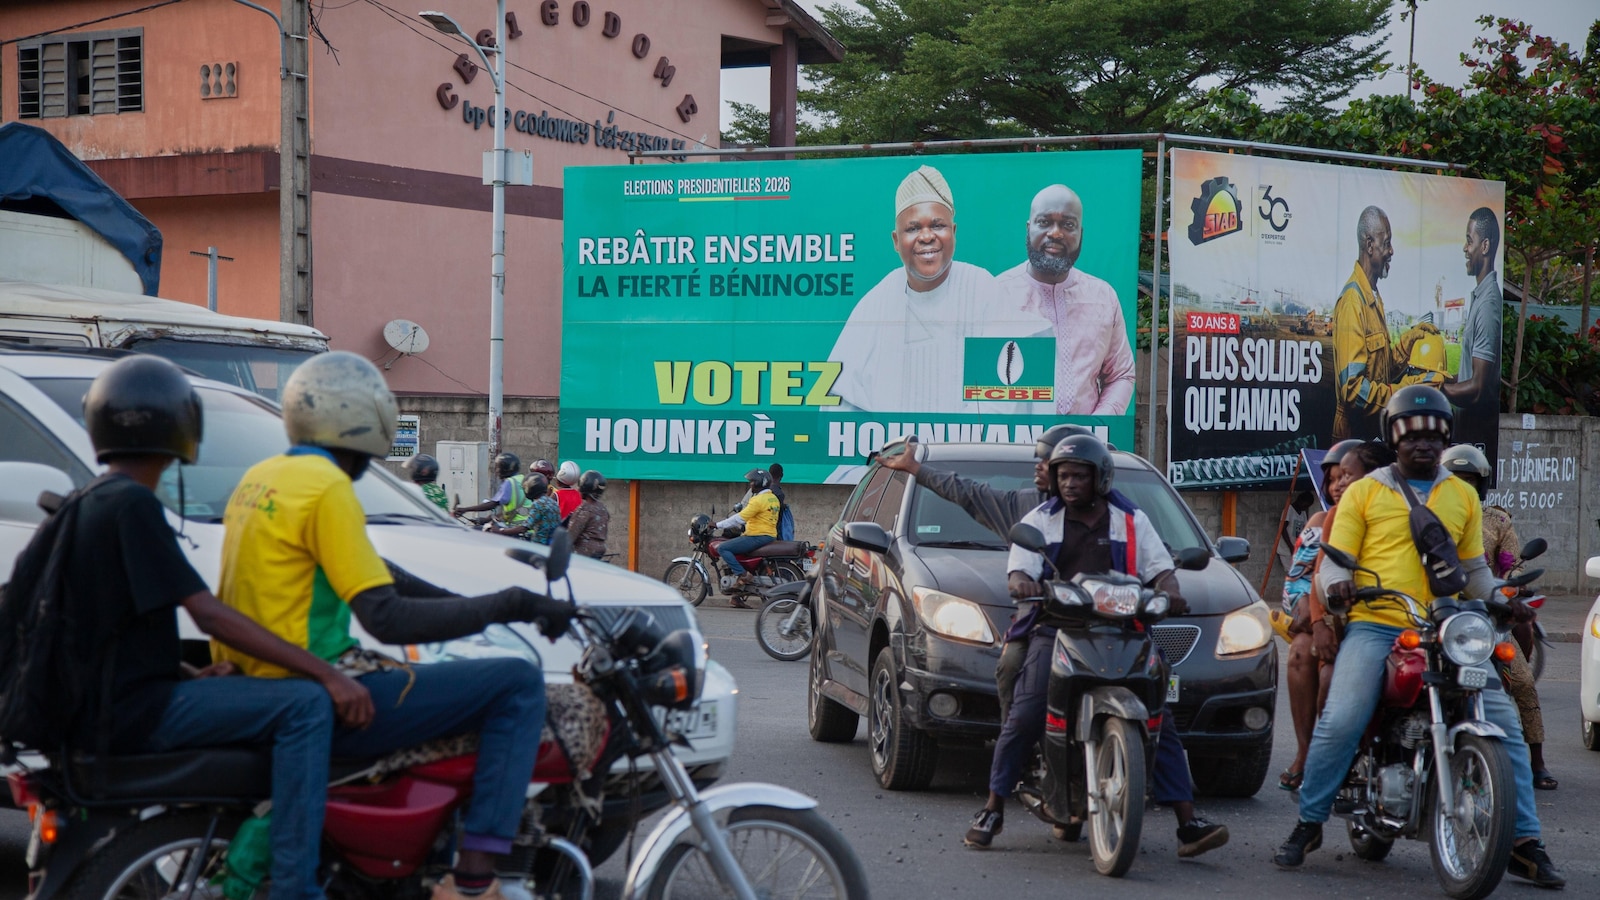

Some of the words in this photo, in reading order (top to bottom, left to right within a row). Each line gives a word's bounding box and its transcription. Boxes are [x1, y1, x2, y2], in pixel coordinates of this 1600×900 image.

[463, 100, 486, 130] bp
[623, 180, 674, 196] ELECTIONS
[677, 178, 761, 195] PRESIDENTIELLES
[764, 176, 790, 193] 2026
[1203, 211, 1238, 235] SIAB
[578, 229, 696, 266] REBÂTIR
[704, 233, 856, 265] ENSEMBLE
[577, 275, 609, 298] LA
[617, 268, 702, 298] FIERTÉ
[709, 267, 855, 297] BÉNINOISE
[1190, 315, 1204, 328] 30
[1205, 316, 1227, 330] ANS
[1228, 319, 1237, 331] &
[1185, 335, 1240, 382] PLUS
[1240, 337, 1323, 384] SOLIDES
[653, 360, 843, 406] VOTEZ
[965, 389, 1052, 400] FCBE
[1184, 386, 1227, 435] QUE
[1227, 387, 1301, 433] JAMAIS
[584, 413, 776, 456] HOUNKPÈ
[827, 420, 1110, 457] HONWAN
[1561, 456, 1576, 482] ICI
[1482, 488, 1514, 509] ende
